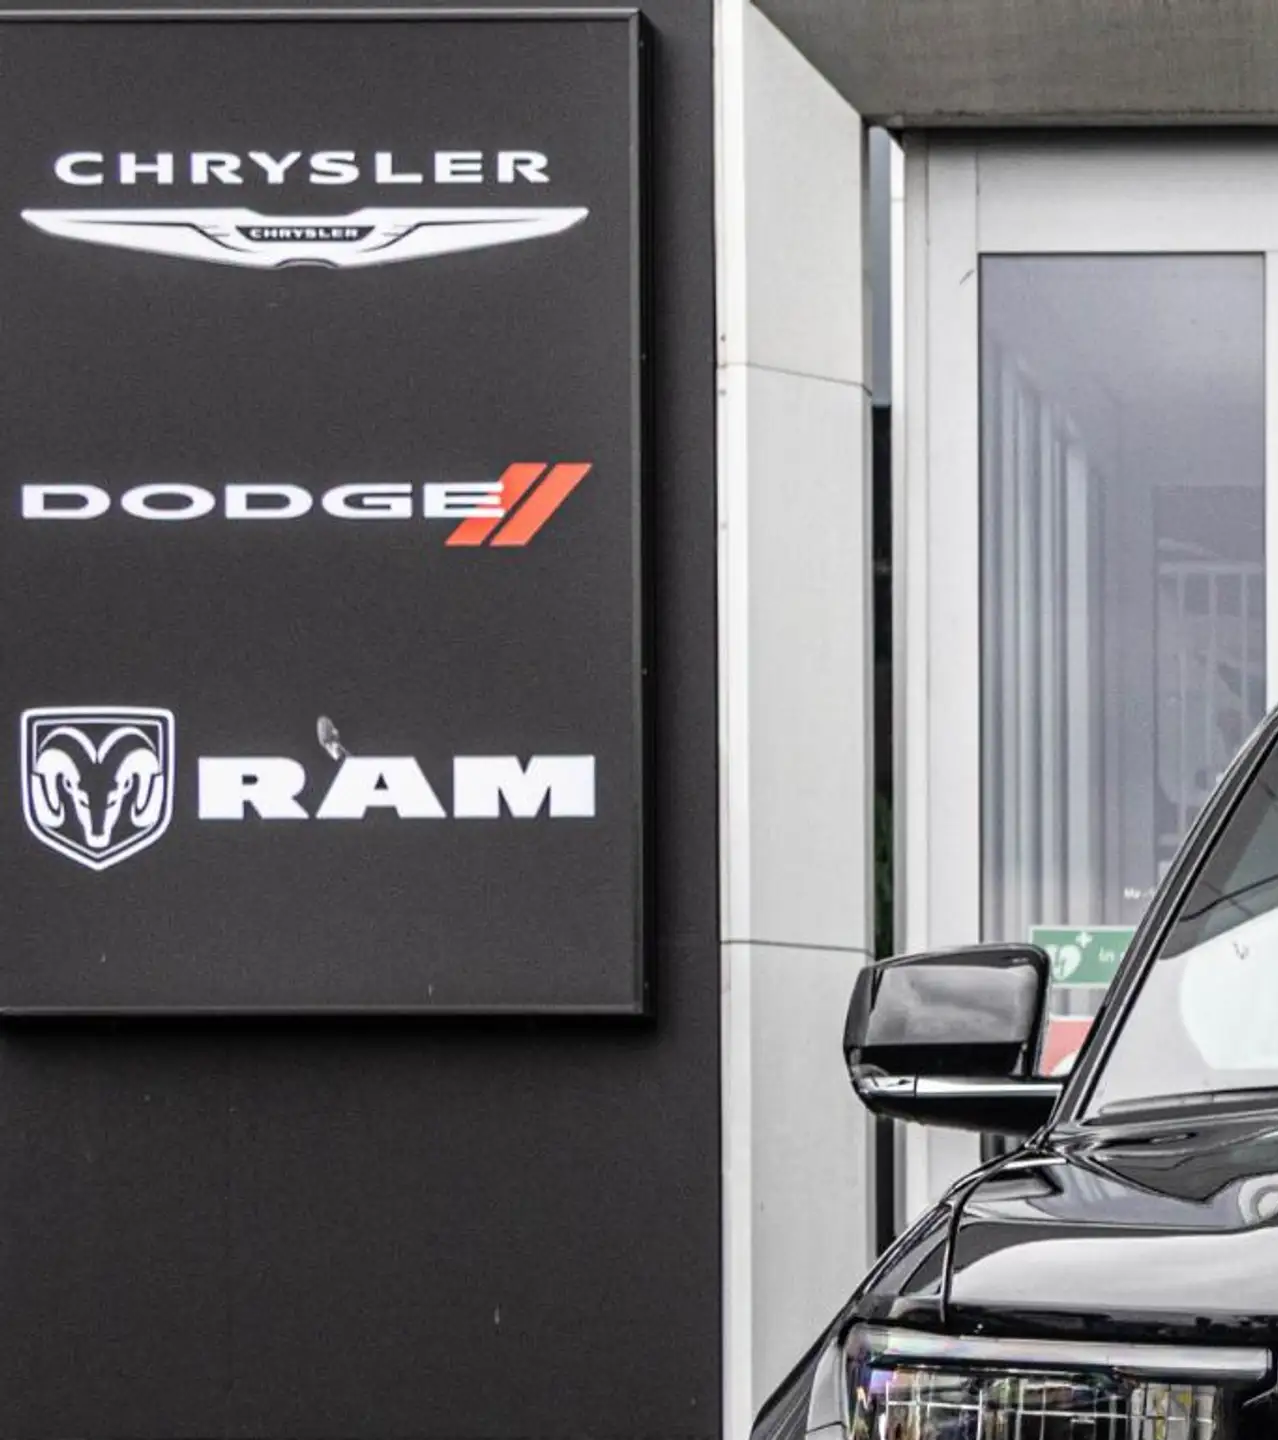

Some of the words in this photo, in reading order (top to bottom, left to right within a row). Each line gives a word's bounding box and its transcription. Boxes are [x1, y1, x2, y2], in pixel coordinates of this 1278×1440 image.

[55, 151, 550, 185] CHRYSLER
[249, 227, 359, 240] CHRYSLER
[21, 482, 505, 519] DODGE
[198, 754, 596, 819] RAM
